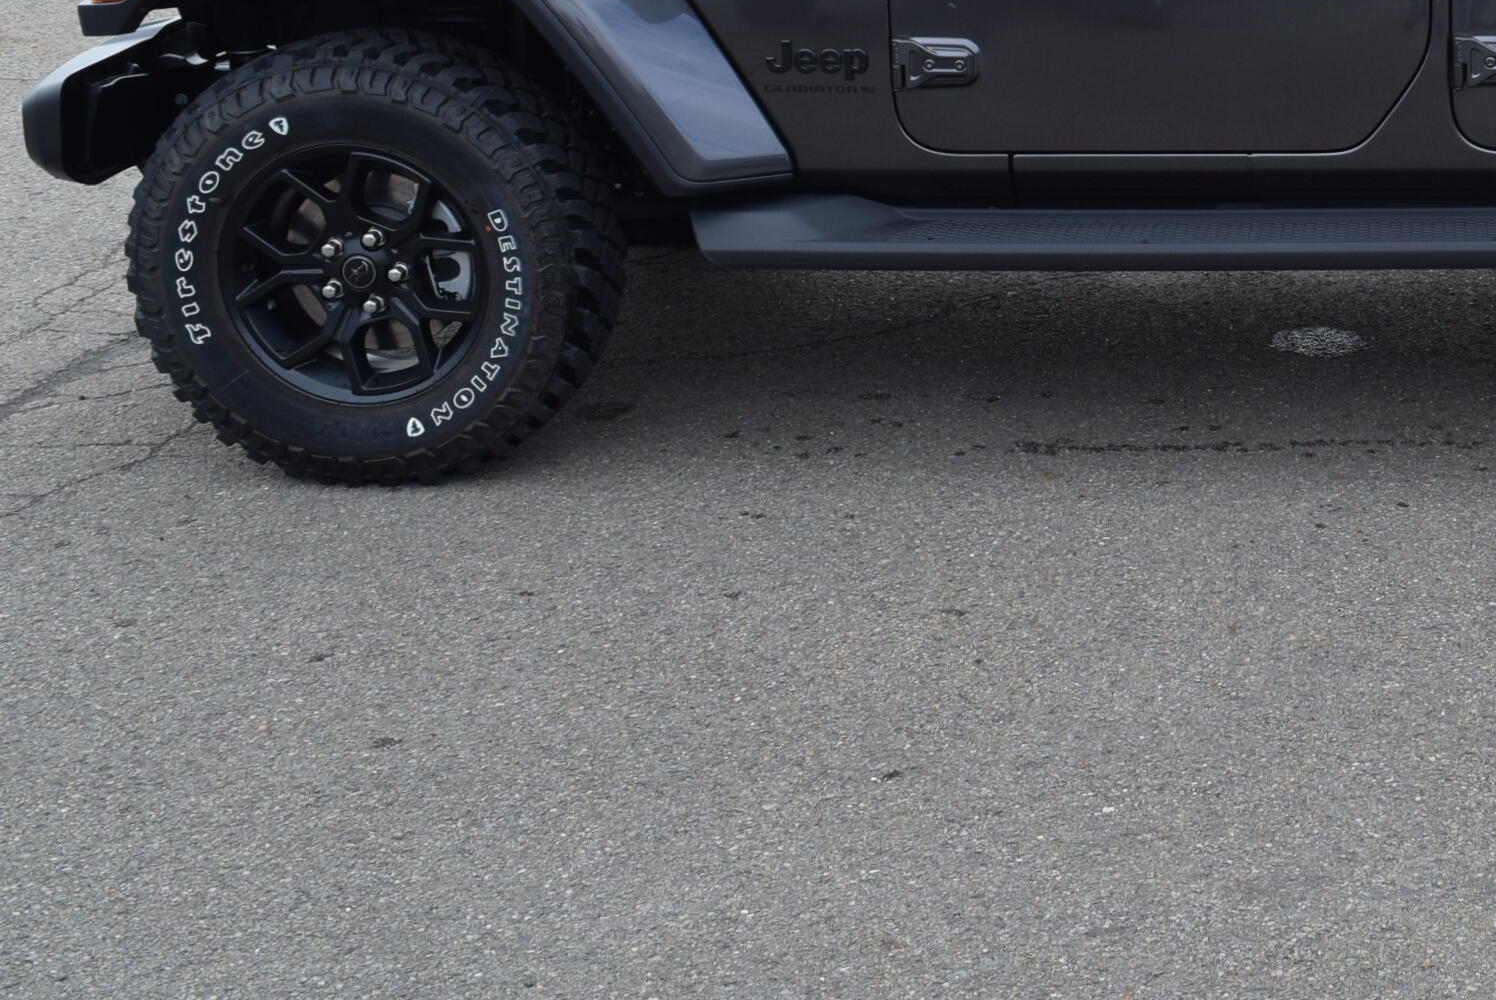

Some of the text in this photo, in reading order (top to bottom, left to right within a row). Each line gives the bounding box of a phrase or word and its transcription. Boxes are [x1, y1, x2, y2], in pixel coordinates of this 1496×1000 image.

[763, 84, 858, 94] GLADIATOR
[765, 39, 869, 81] Jeep
[175, 130, 265, 344] Firestone
[431, 209, 522, 427] DESTINATION
